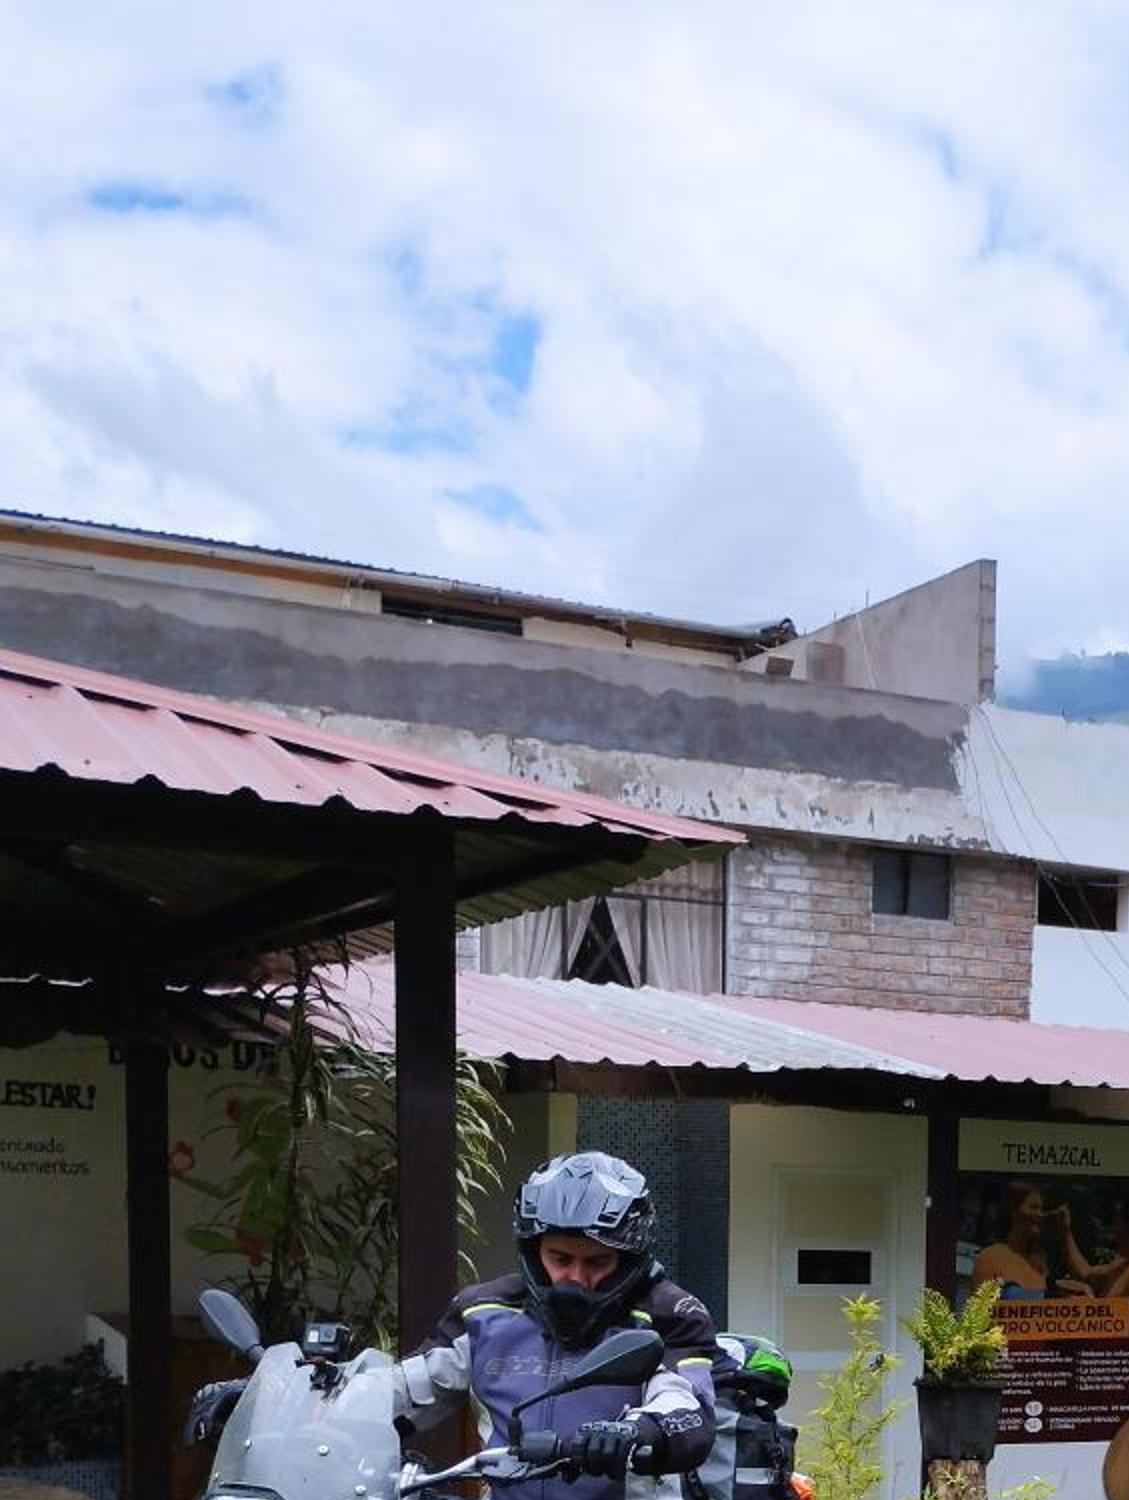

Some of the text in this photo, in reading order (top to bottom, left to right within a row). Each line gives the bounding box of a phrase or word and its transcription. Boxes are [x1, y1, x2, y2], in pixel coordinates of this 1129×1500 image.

[0, 1080, 96, 1110] ESTAR!
[1003, 1143, 1101, 1167] TEMAZCAL
[1085, 1304, 1114, 1318] DEL
